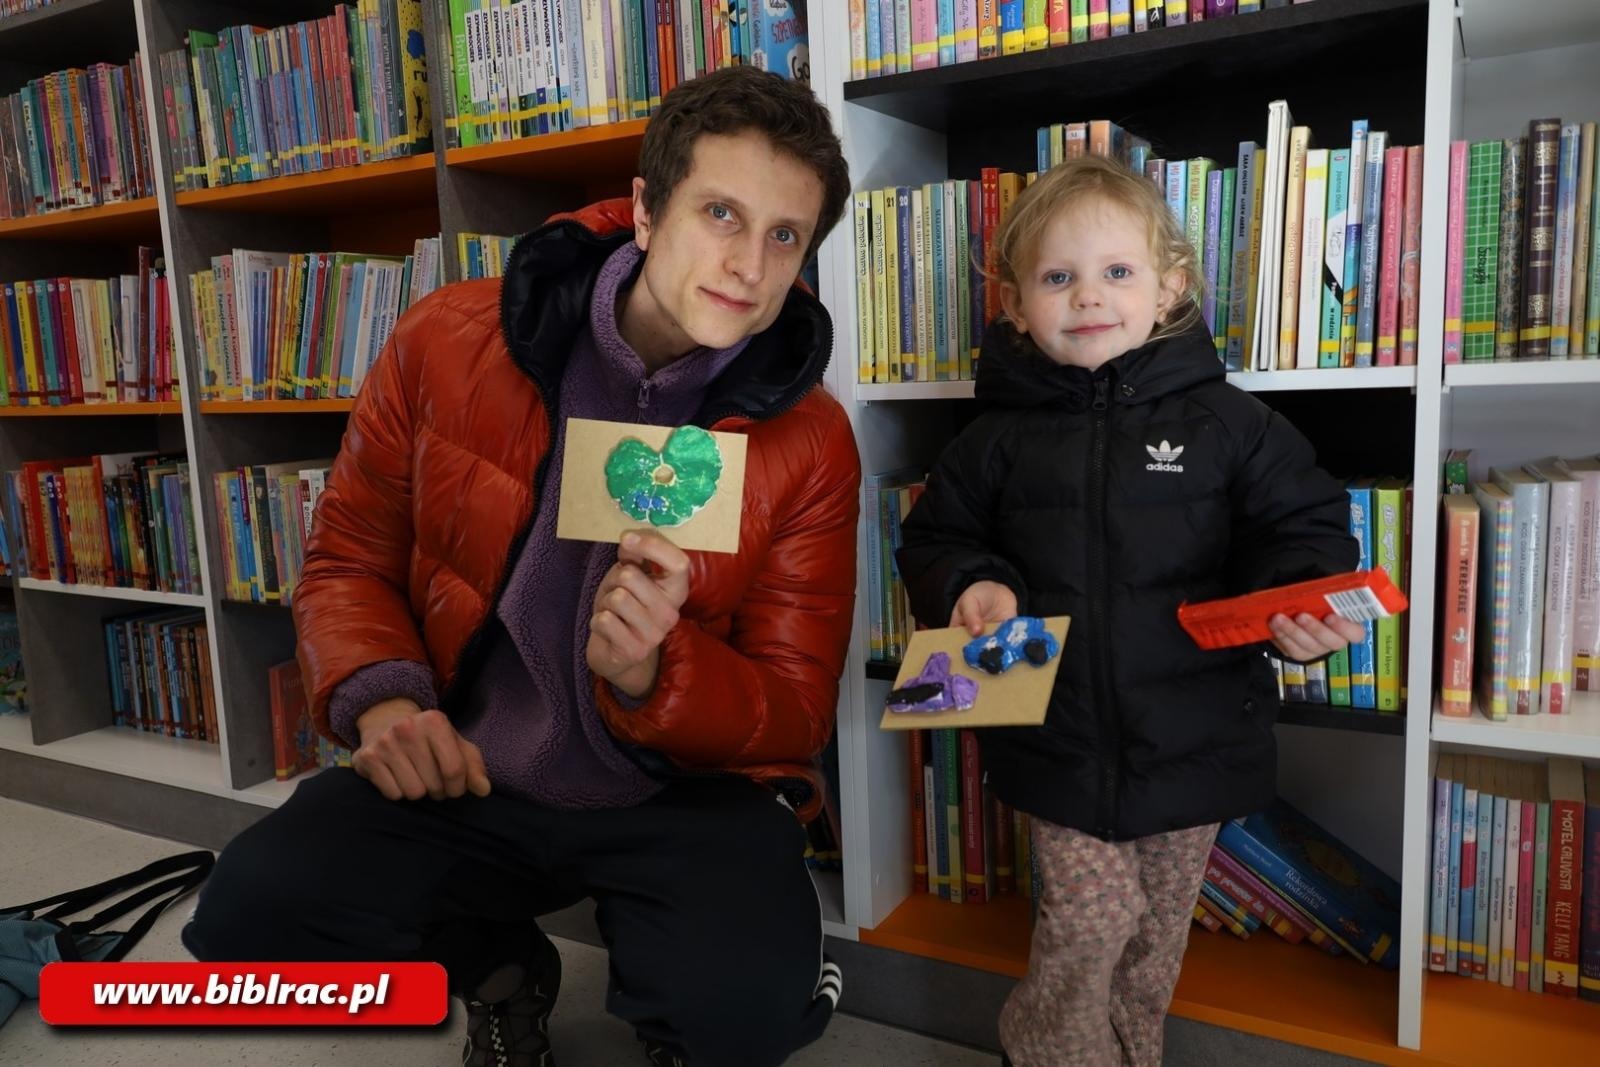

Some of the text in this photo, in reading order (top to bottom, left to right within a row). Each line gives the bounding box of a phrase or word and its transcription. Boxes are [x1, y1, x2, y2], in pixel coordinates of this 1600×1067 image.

[454, 34, 467, 77] Bratki
[886, 197, 896, 209] 21
[899, 197, 908, 208] 20
[1145, 462, 1184, 472] adidas
[1553, 545, 1561, 567] OSKAR
[1553, 809, 1574, 958] MOTEL CALIVISTA KELLY YANG
